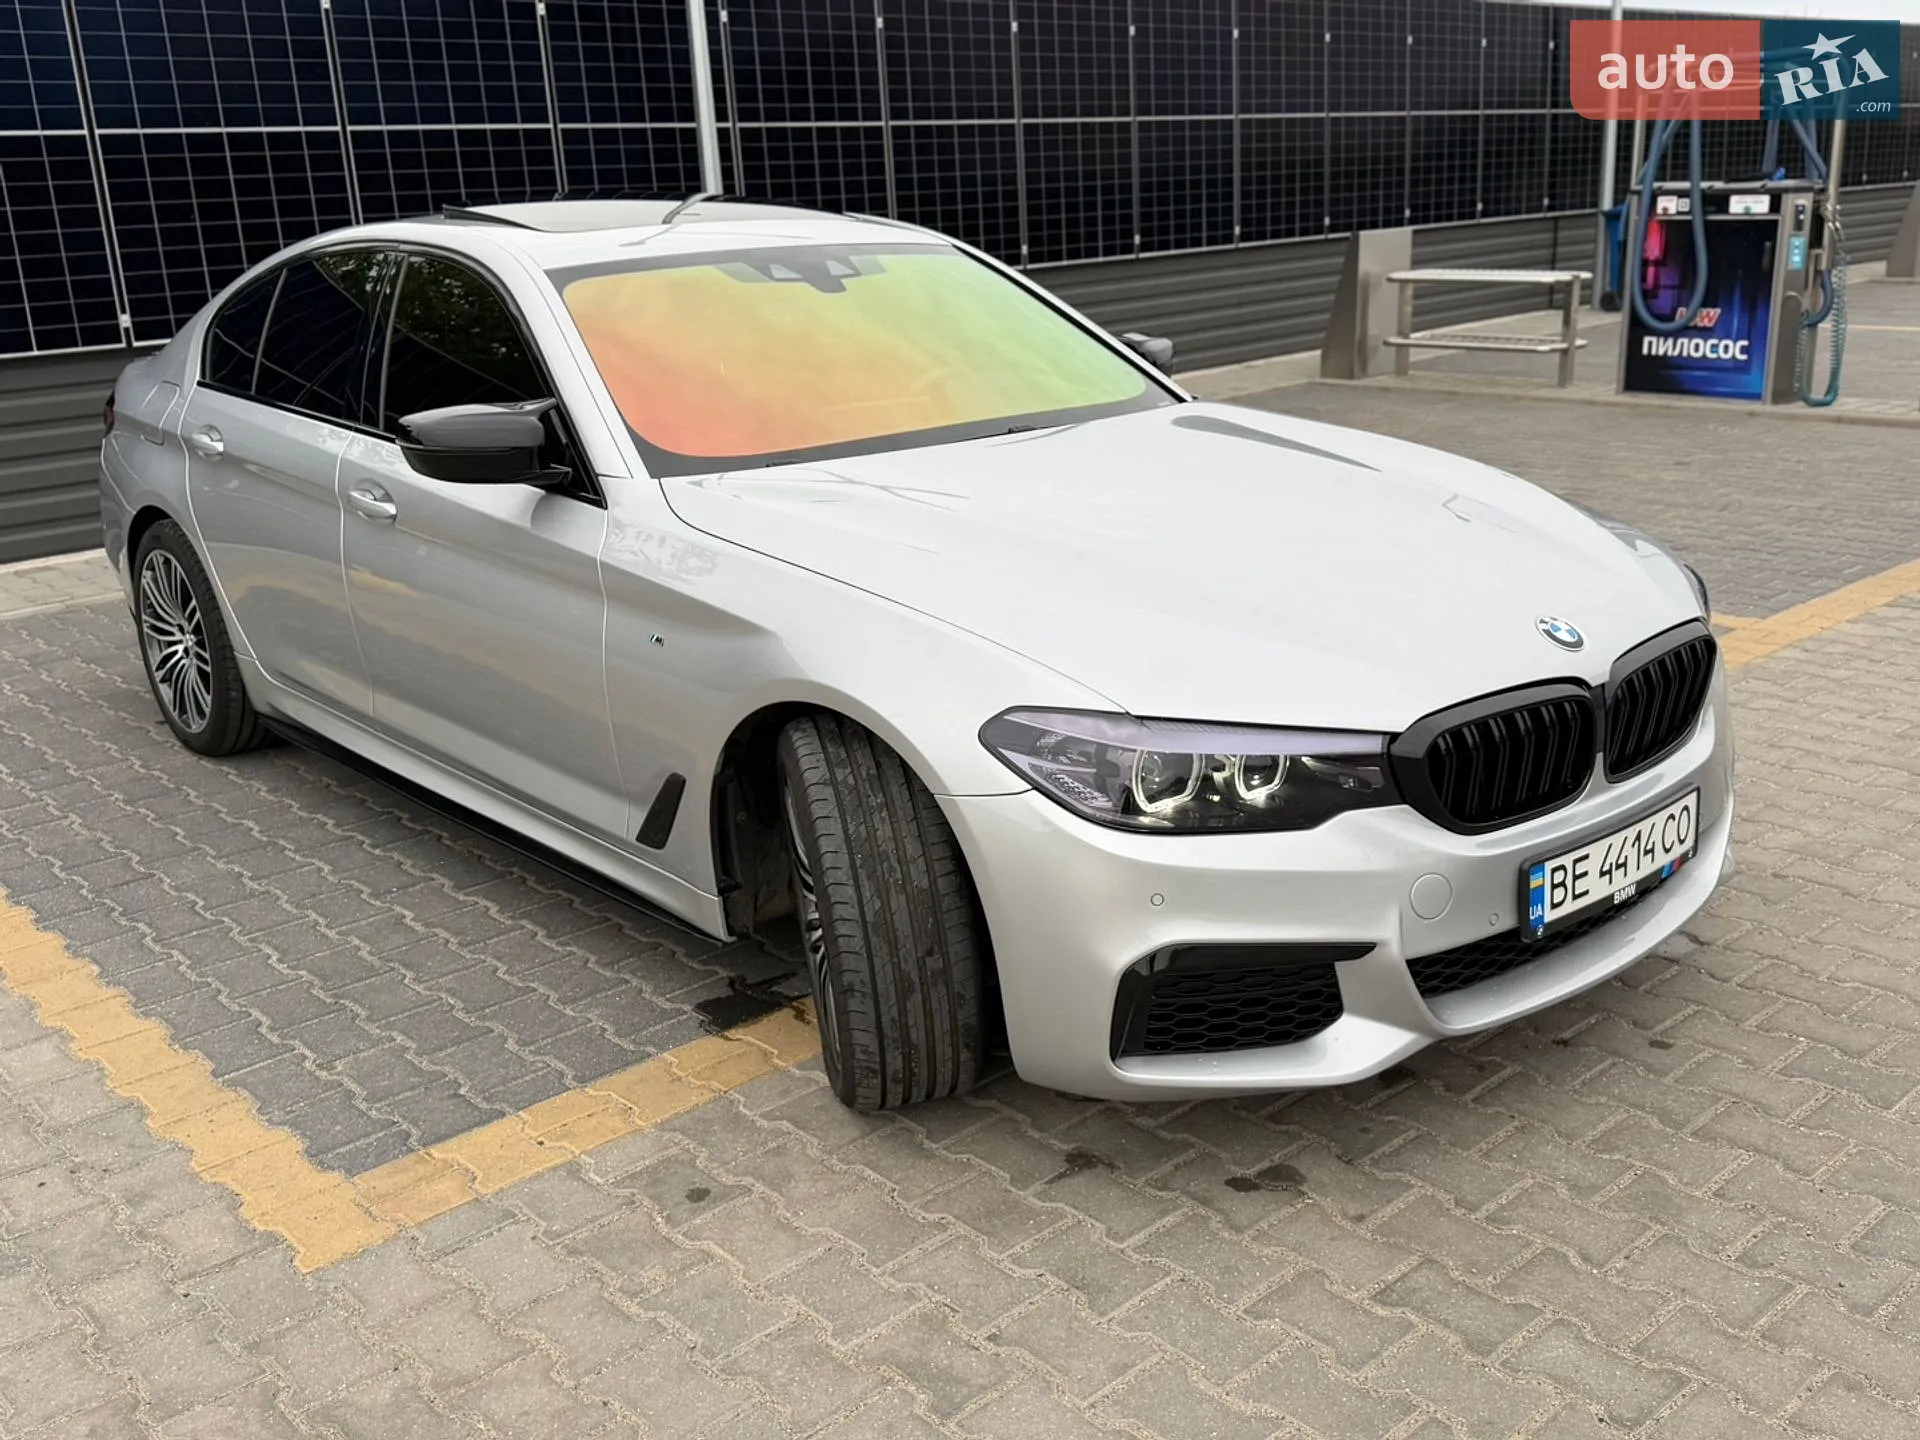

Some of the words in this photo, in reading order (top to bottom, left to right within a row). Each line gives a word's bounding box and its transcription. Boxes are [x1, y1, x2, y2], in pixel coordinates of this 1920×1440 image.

[1642, 335, 1749, 360] ПИЛОСОС
[1550, 853, 1590, 910] BE
[1600, 822, 1656, 885] 4414
[1661, 804, 1691, 854] CO
[1613, 882, 1637, 905] BMW
[1529, 905, 1544, 920] UA
